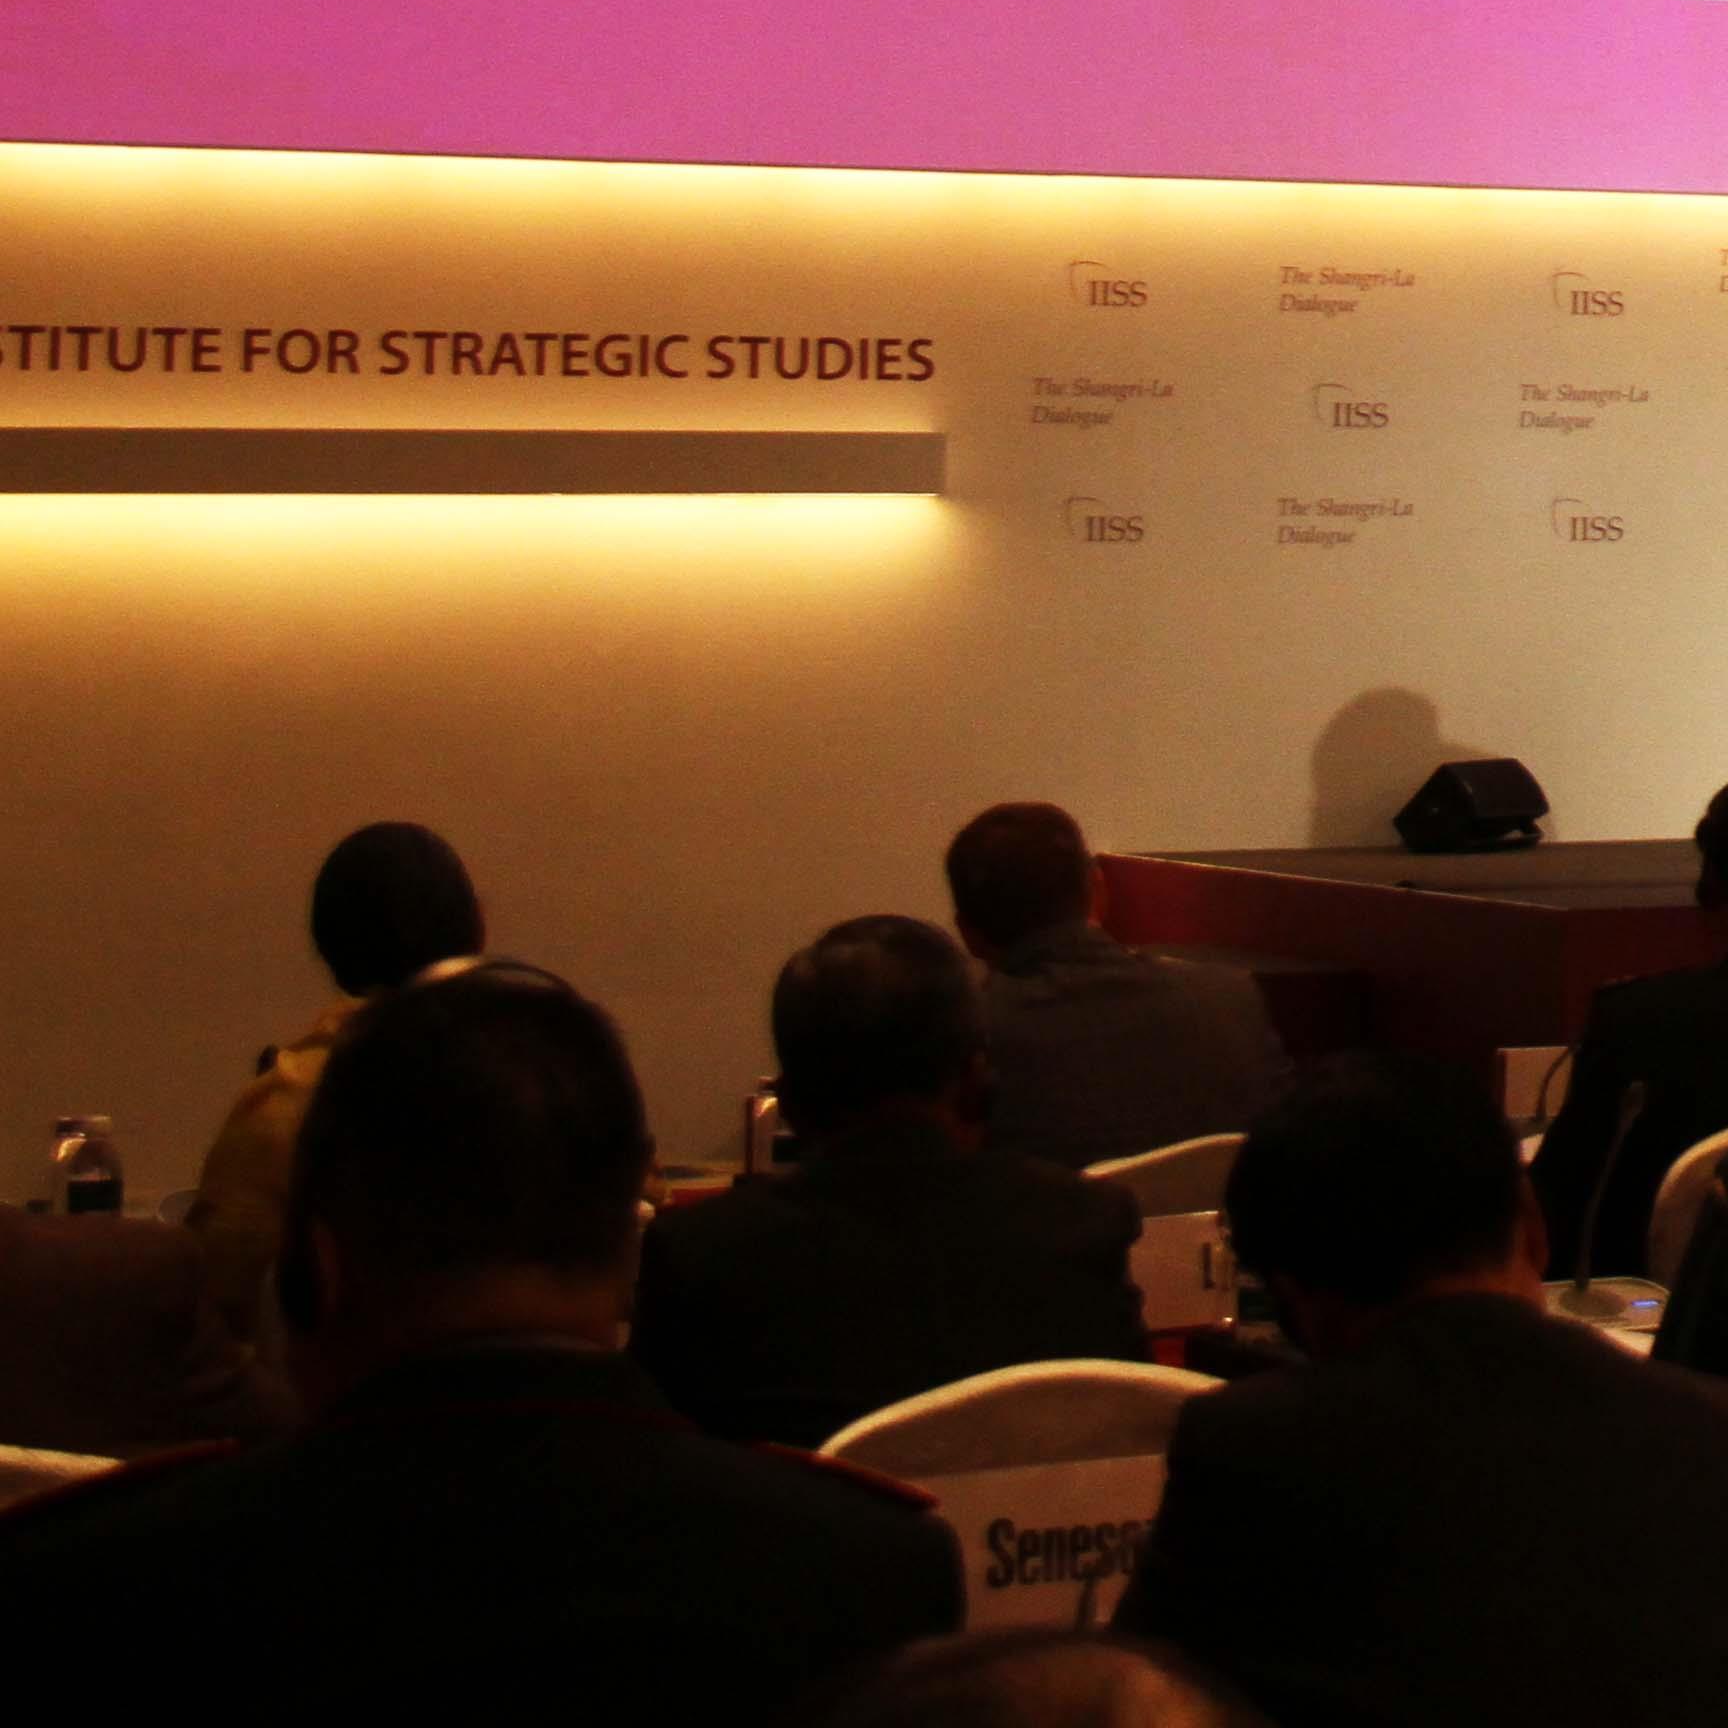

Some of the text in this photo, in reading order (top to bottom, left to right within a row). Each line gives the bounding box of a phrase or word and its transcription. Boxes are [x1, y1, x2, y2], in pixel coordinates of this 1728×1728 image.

[1088, 280, 1148, 307] IISS
[1570, 290, 1624, 316] IISS
[0, 325, 936, 384] TITUTE FOR STRATEGIC STUDIES
[1332, 402, 1389, 429] IISS
[1087, 516, 1144, 543] IISS
[1569, 516, 1624, 542] IISS
